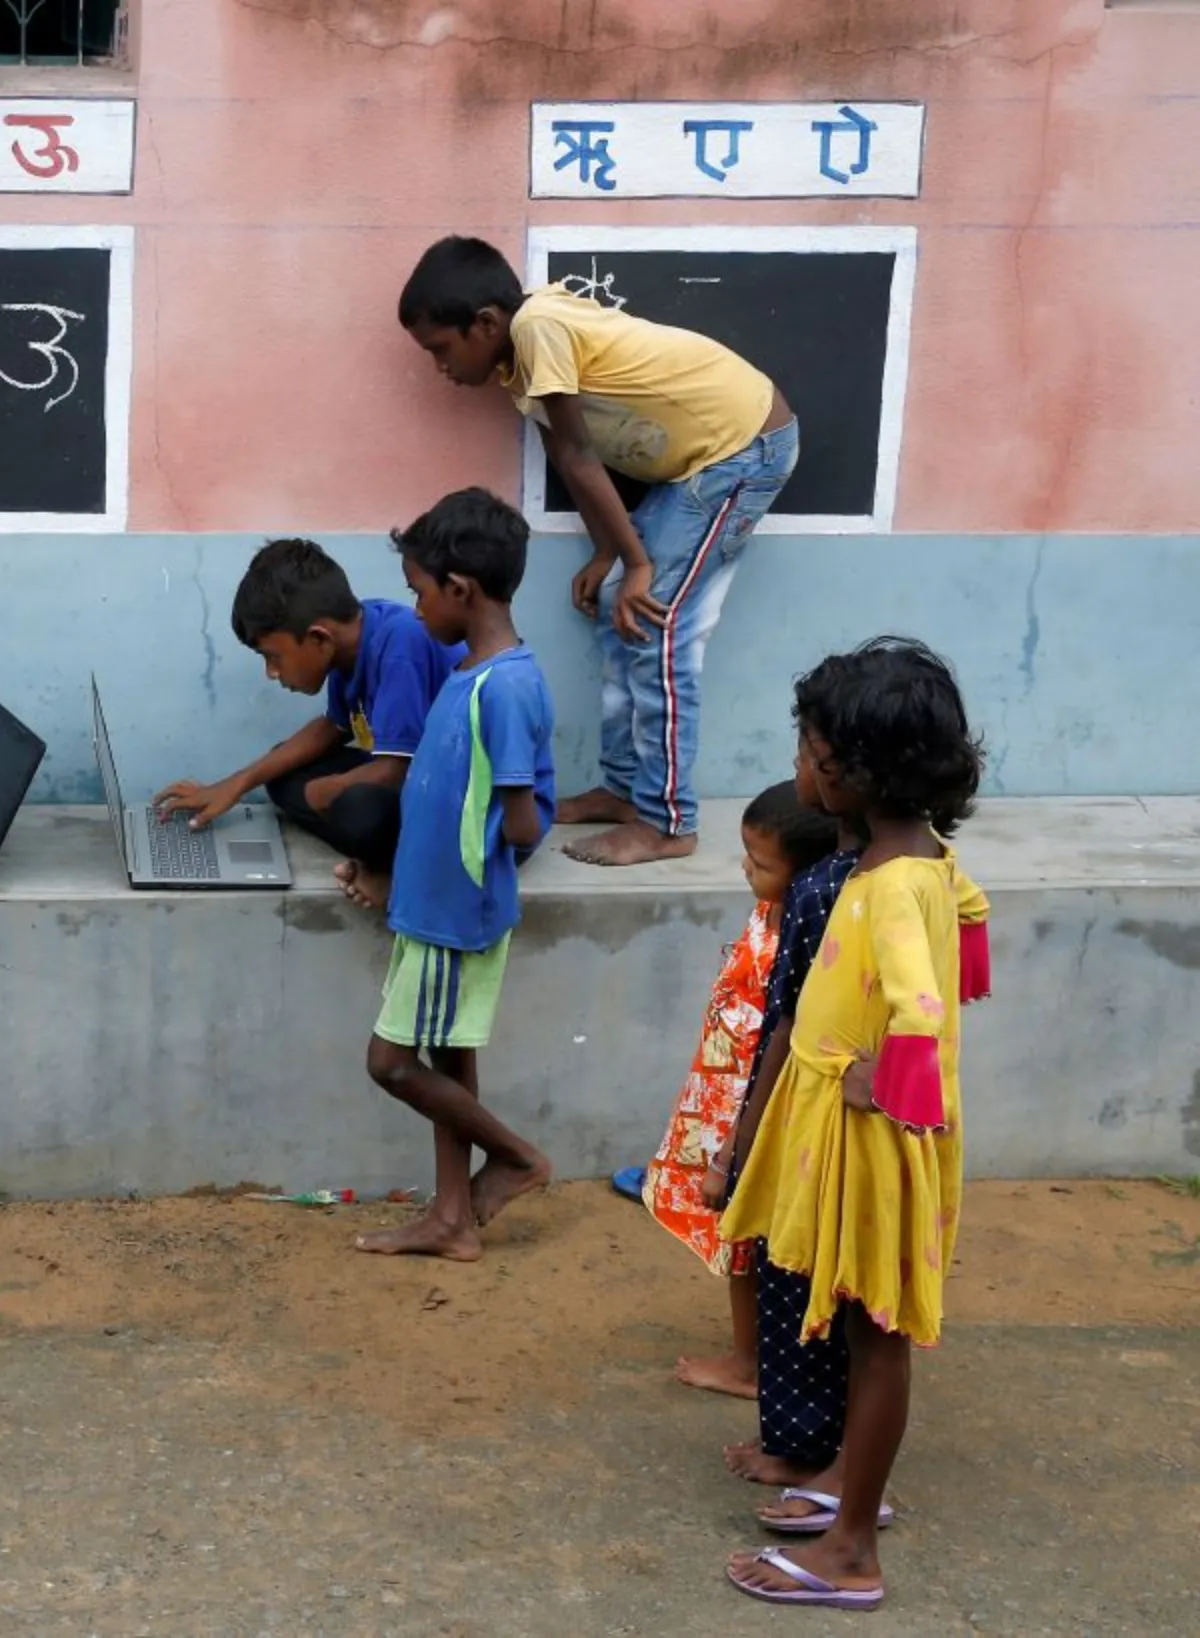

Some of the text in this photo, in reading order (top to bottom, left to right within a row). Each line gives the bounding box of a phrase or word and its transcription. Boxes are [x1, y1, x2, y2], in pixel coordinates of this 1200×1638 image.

[3, 113, 79, 179] ऊ
[551, 105, 879, 191] ऋ ए ऐ
